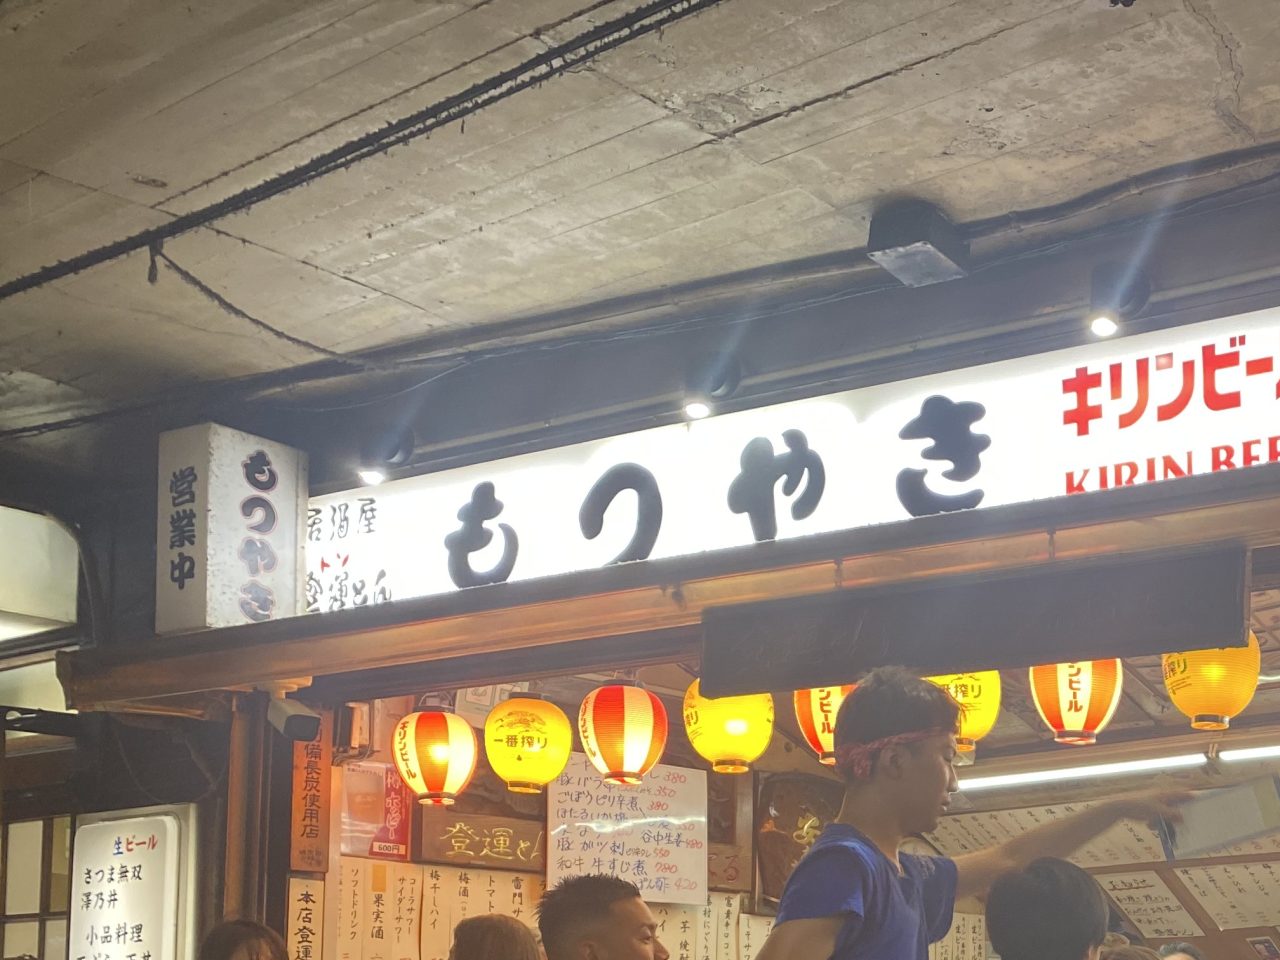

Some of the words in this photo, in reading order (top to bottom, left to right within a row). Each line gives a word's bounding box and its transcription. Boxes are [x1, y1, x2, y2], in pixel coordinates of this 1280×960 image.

[444, 395, 991, 588] もつやき
[1065, 451, 1193, 495] KIRIN
[169, 466, 198, 590] 営業中
[238, 449, 278, 622] もつやき
[398, 720, 417, 780] キリンビール
[494, 734, 549, 749] 一番搾り
[301, 722, 322, 839] 備長炭使用店
[654, 785, 677, 798] 350
[664, 771, 687, 784] 380
[647, 802, 669, 811] 380
[113, 834, 158, 855] 生ビール
[84, 864, 143, 885] さつま無双
[654, 862, 678, 873] 780
[674, 880, 697, 891] 420
[350, 868, 361, 941] ソフトドリンク
[370, 893, 385, 940] 果実酒
[395, 877, 407, 943] サイダーサワー
[406, 878, 416, 935] コーラサワー
[429, 869, 441, 930] 梅干しハイ
[86, 922, 144, 945] 小品料理
